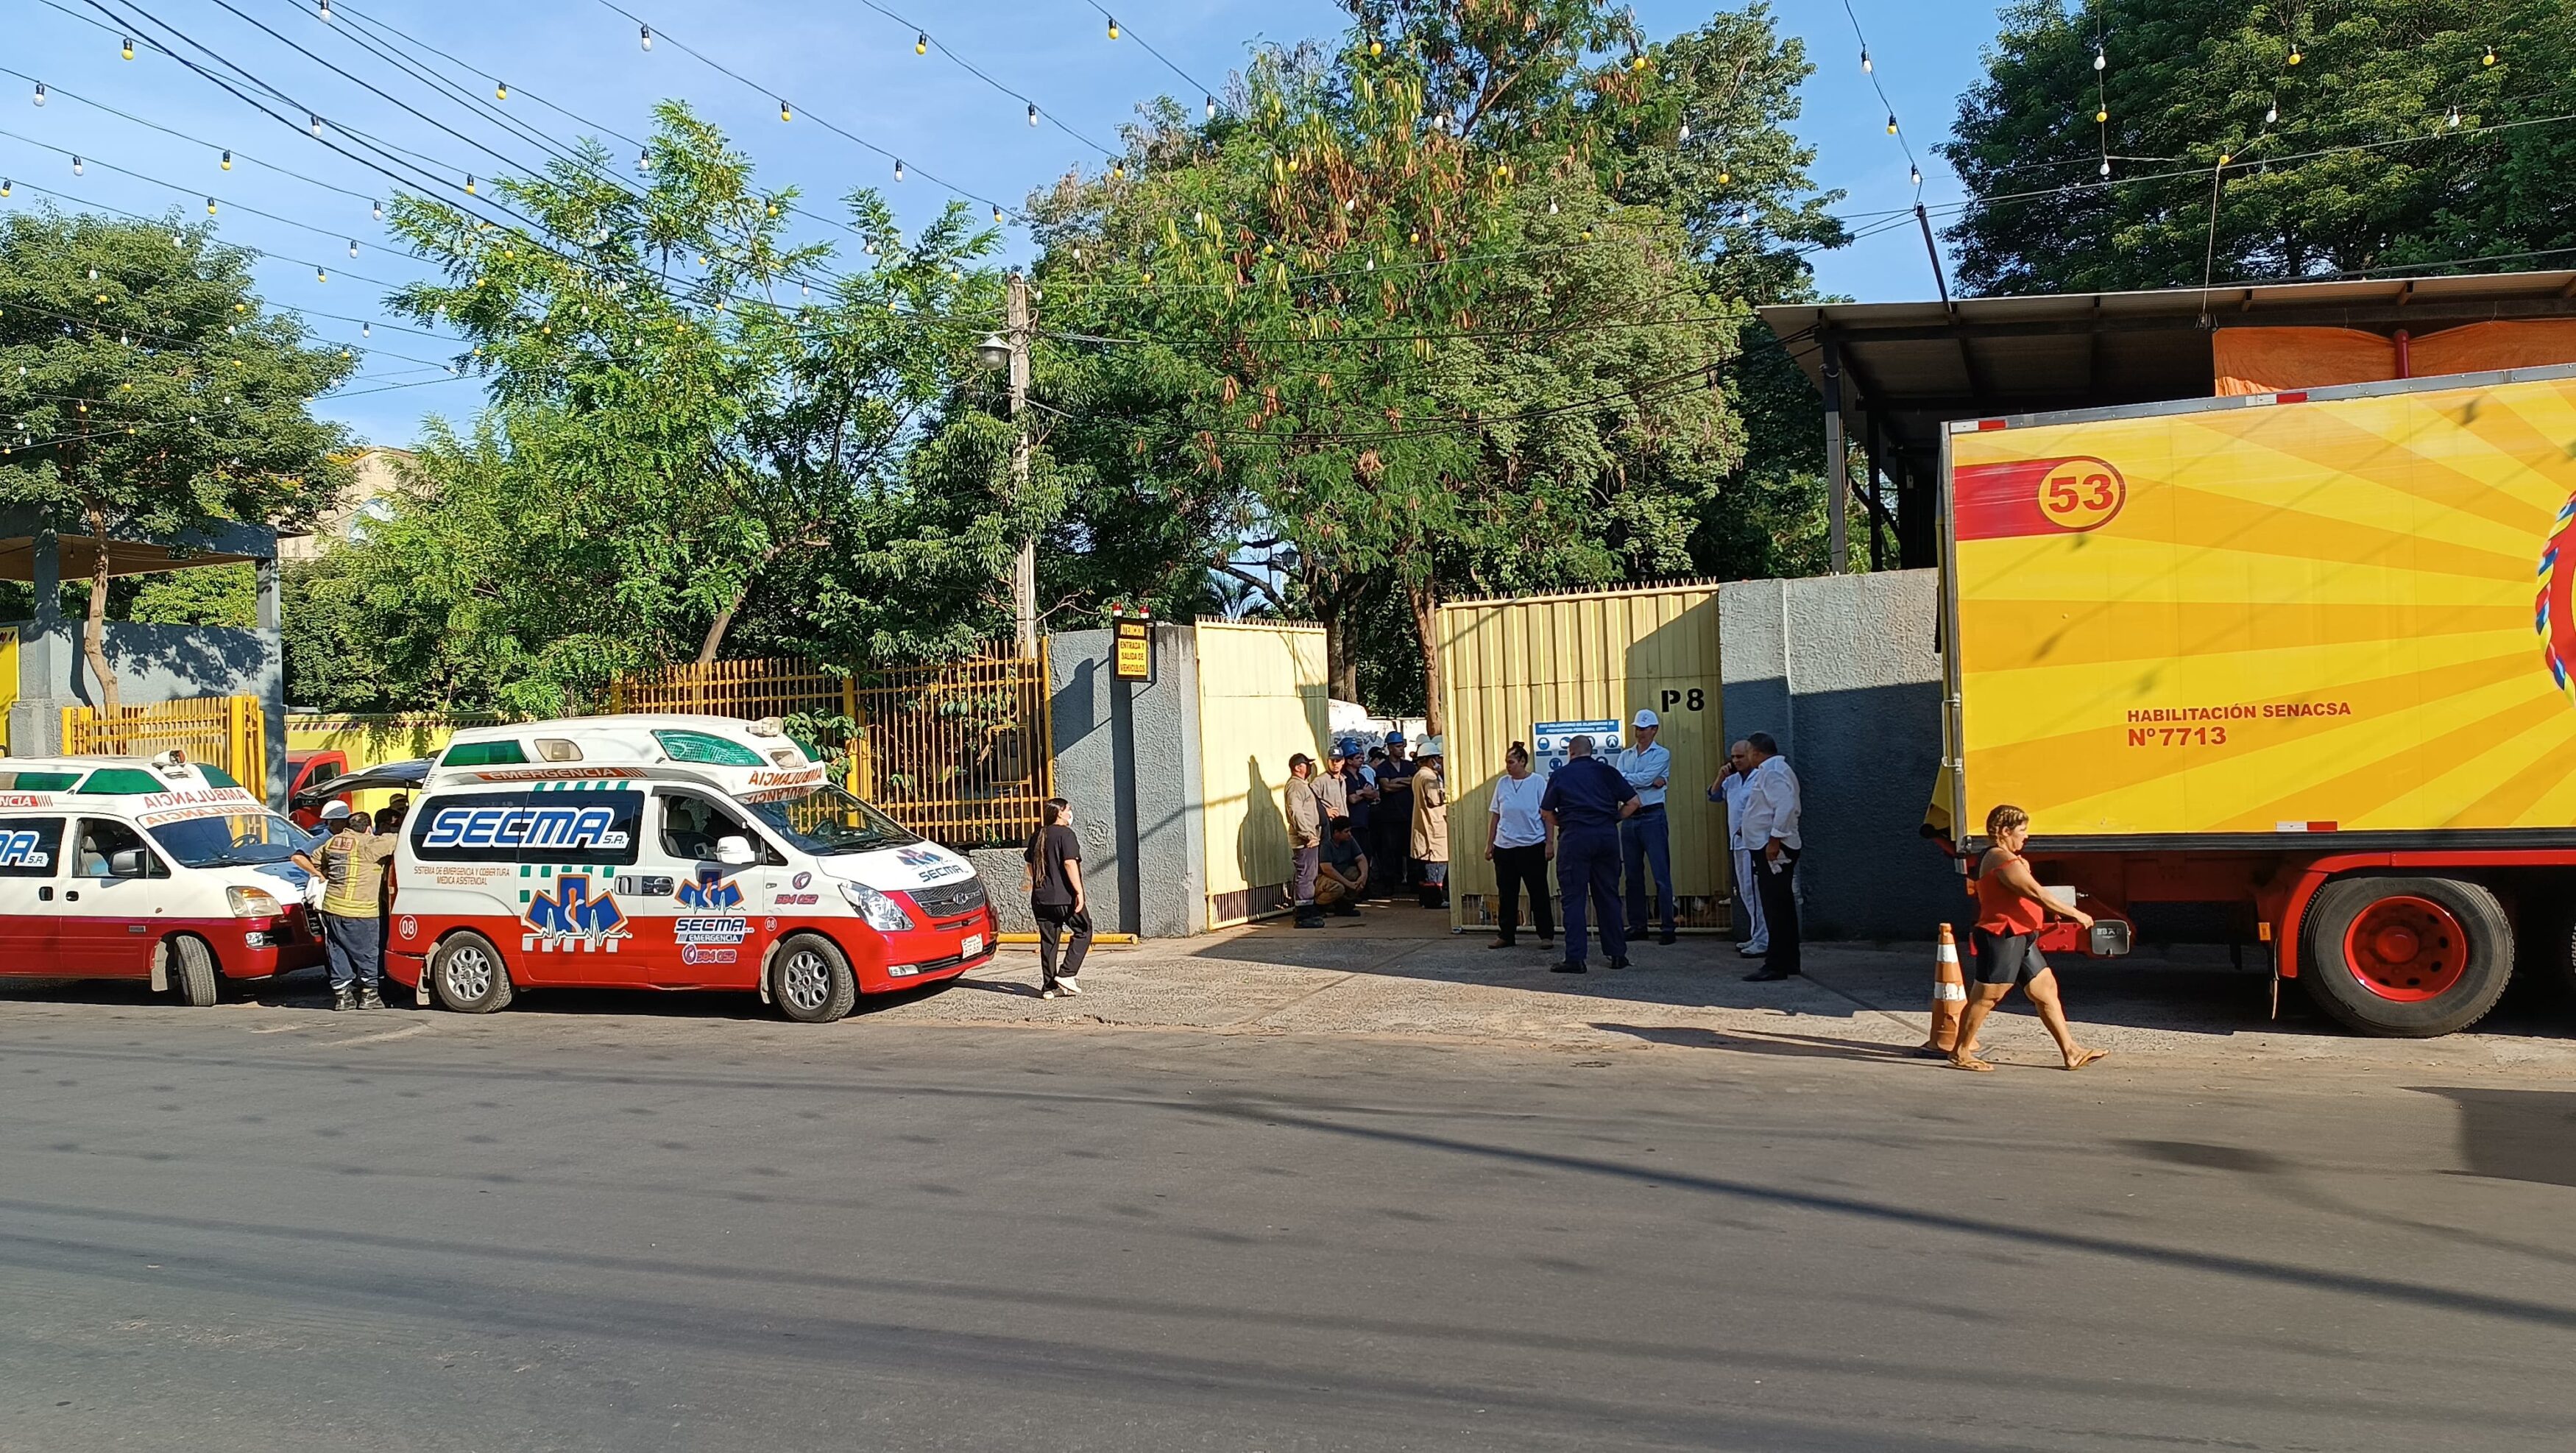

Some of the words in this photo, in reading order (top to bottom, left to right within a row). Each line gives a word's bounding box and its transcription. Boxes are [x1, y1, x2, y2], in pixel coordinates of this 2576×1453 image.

[2048, 474, 2114, 513] 53
[2128, 704, 2257, 722] HABILITACIÓN
[2262, 702, 2351, 718] SENACSA
[489, 768, 617, 779] EMERGENCIA
[428, 811, 612, 844] SECMA
[603, 835, 624, 844] S.A.
[414, 866, 434, 874] SISTEMA
[443, 867, 473, 875] EMERGENCIA
[479, 868, 509, 876] COBERTURA
[919, 865, 963, 883] SECMA
[456, 877, 486, 885] ASISTENCIAL
[402, 919, 414, 935] 08
[676, 919, 745, 931] SECMA
[689, 934, 738, 942] EMERGENCIA
